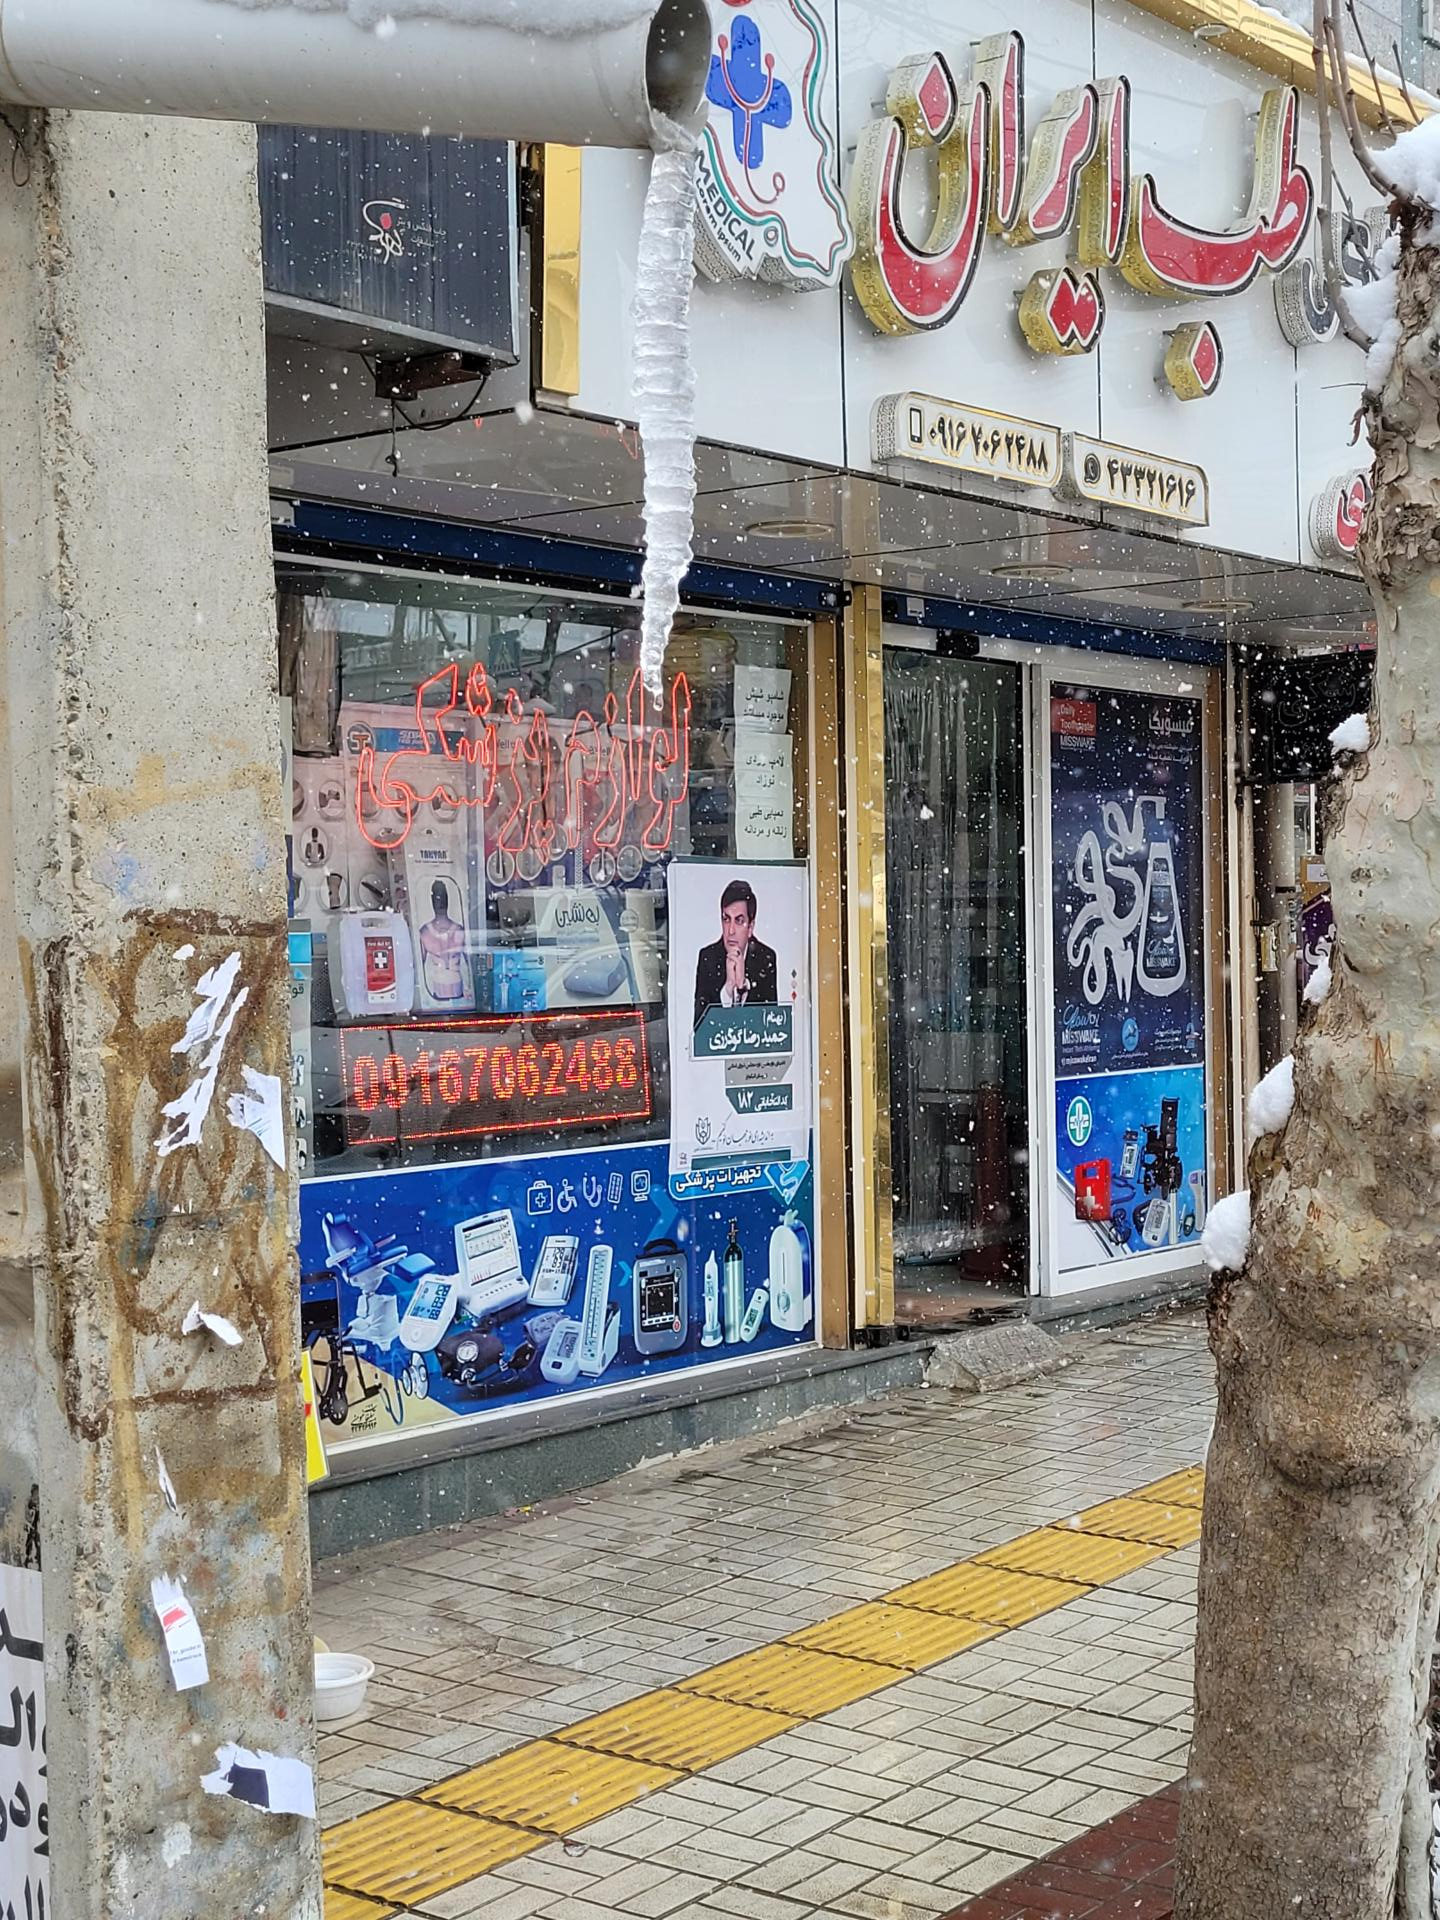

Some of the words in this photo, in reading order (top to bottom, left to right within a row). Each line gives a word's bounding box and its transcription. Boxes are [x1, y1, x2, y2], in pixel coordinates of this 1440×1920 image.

[696, 150, 755, 261] MEDICAL
[860, 30, 1132, 356] ایران
[1133, 85, 1314, 400] طب
[1004, 433, 1049, 474] ۲۴۸۸
[1106, 456, 1196, 511] ۴۳۳۲۱۶۱۶
[354, 661, 553, 865] پزشکی
[565, 667, 693, 849] لوازم
[352, 1036, 639, 1113] 09167062488
[1062, 1028, 1100, 1045] MISSWAKE
[675, 1167, 716, 1192] پزشکی
[716, 1165, 762, 1187] تجهیزات
